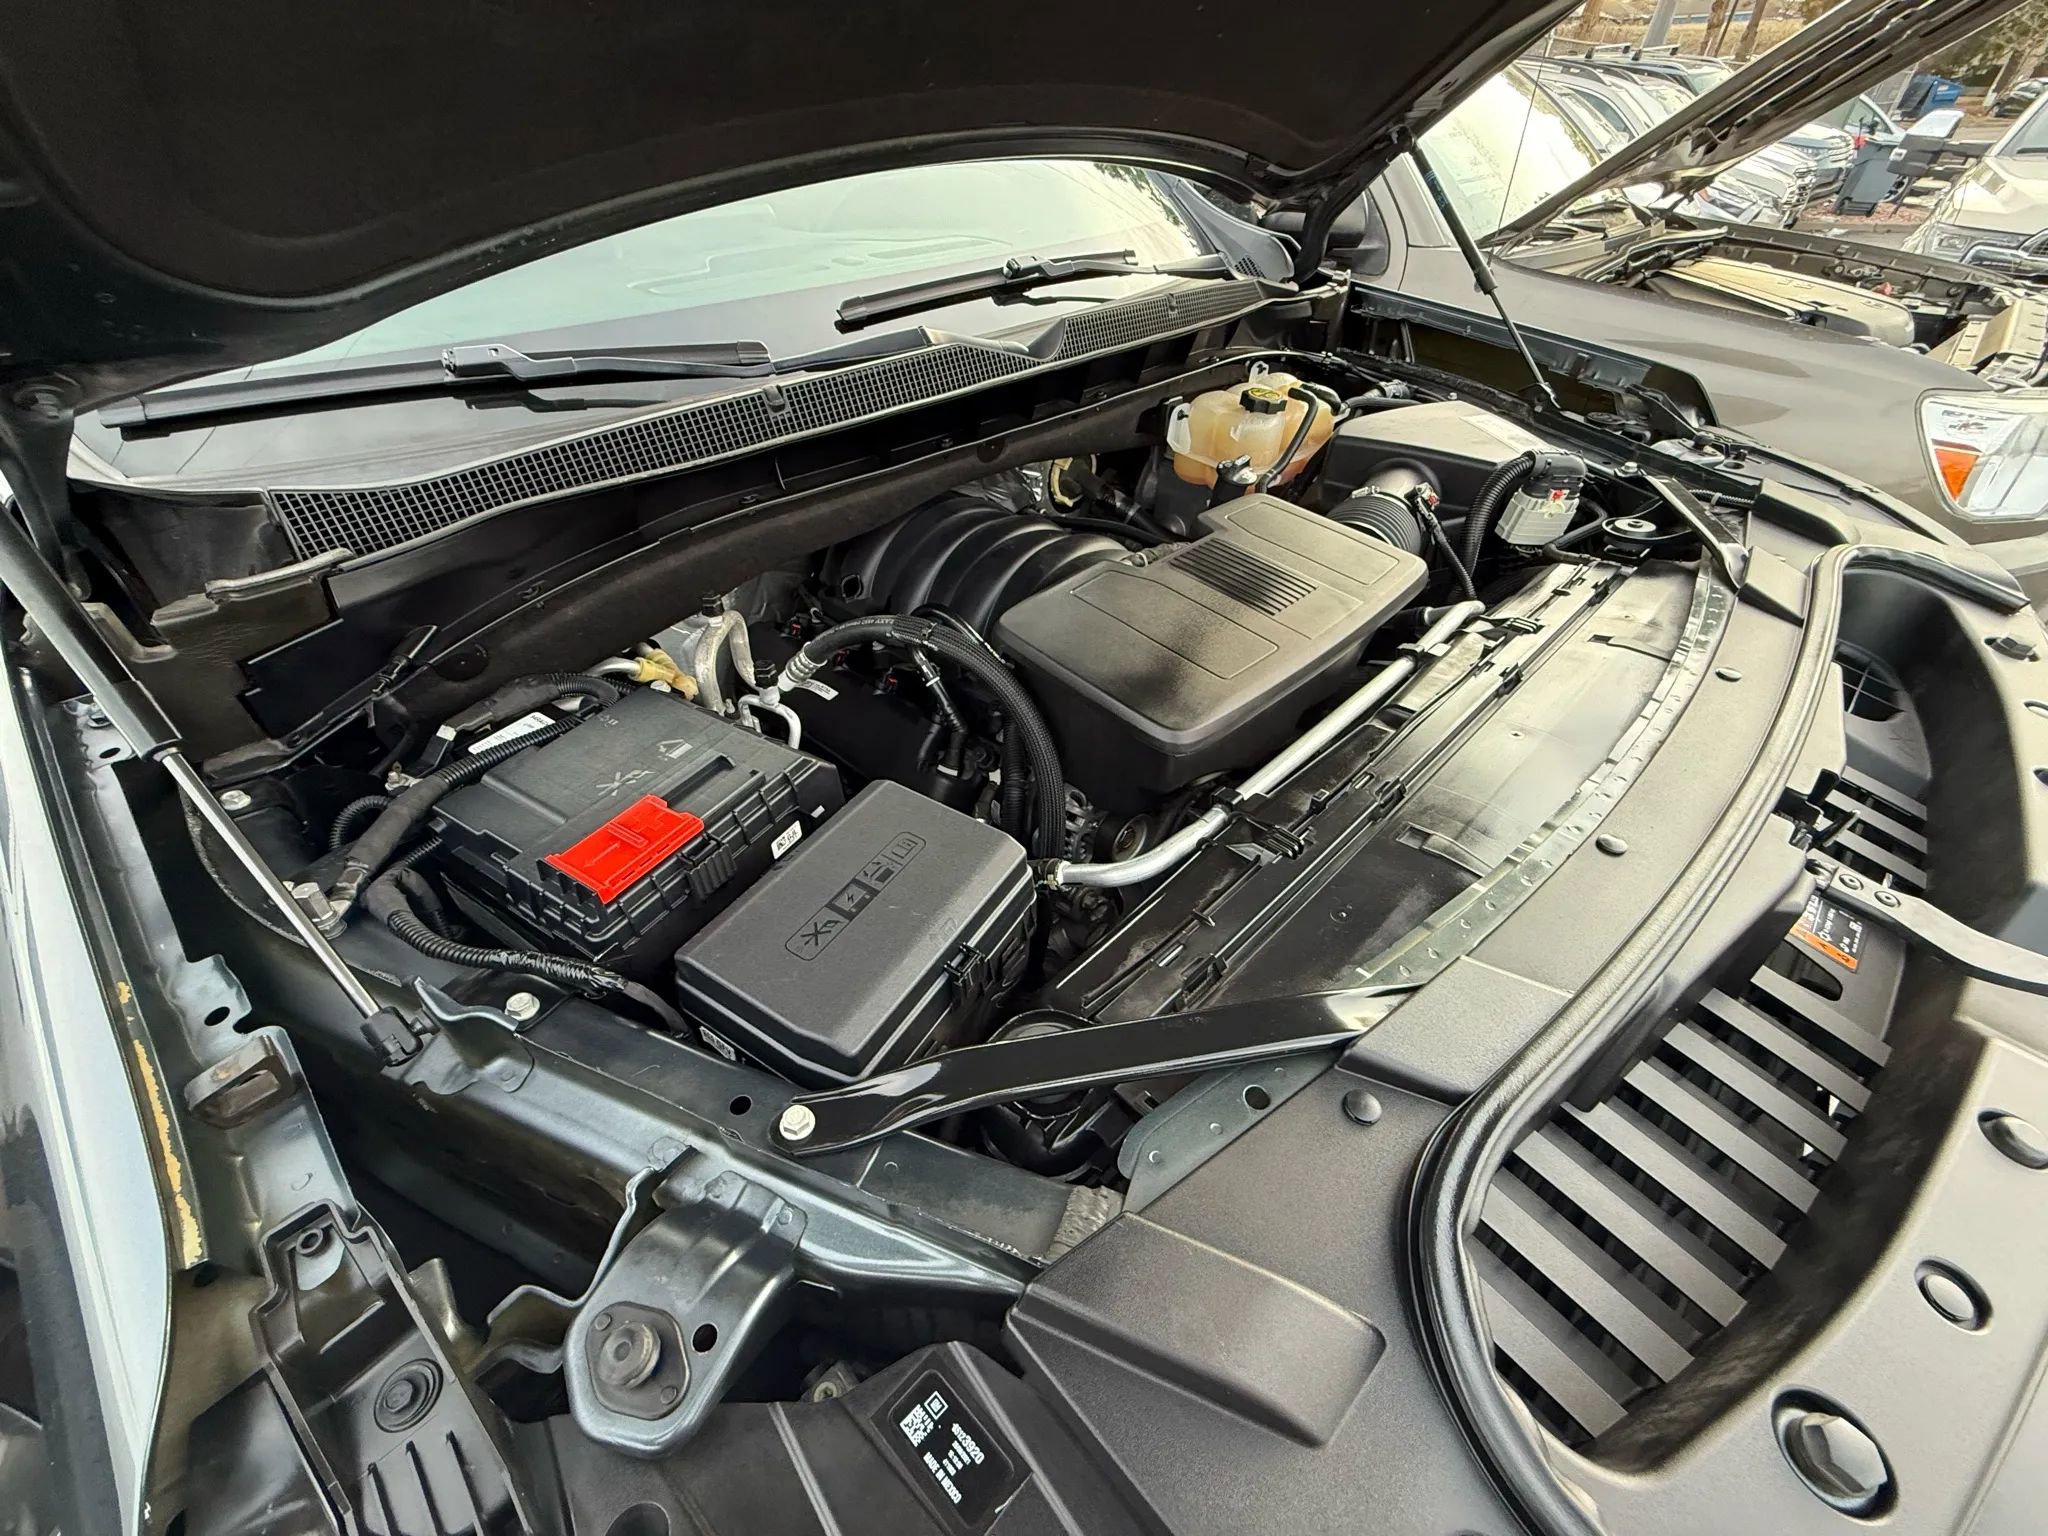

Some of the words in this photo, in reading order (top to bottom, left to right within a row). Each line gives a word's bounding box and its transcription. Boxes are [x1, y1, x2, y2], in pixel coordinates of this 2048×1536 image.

[923, 1451, 940, 1474] MADE
[935, 1468, 946, 1482] IN
[940, 1475, 962, 1504] MEXICO
